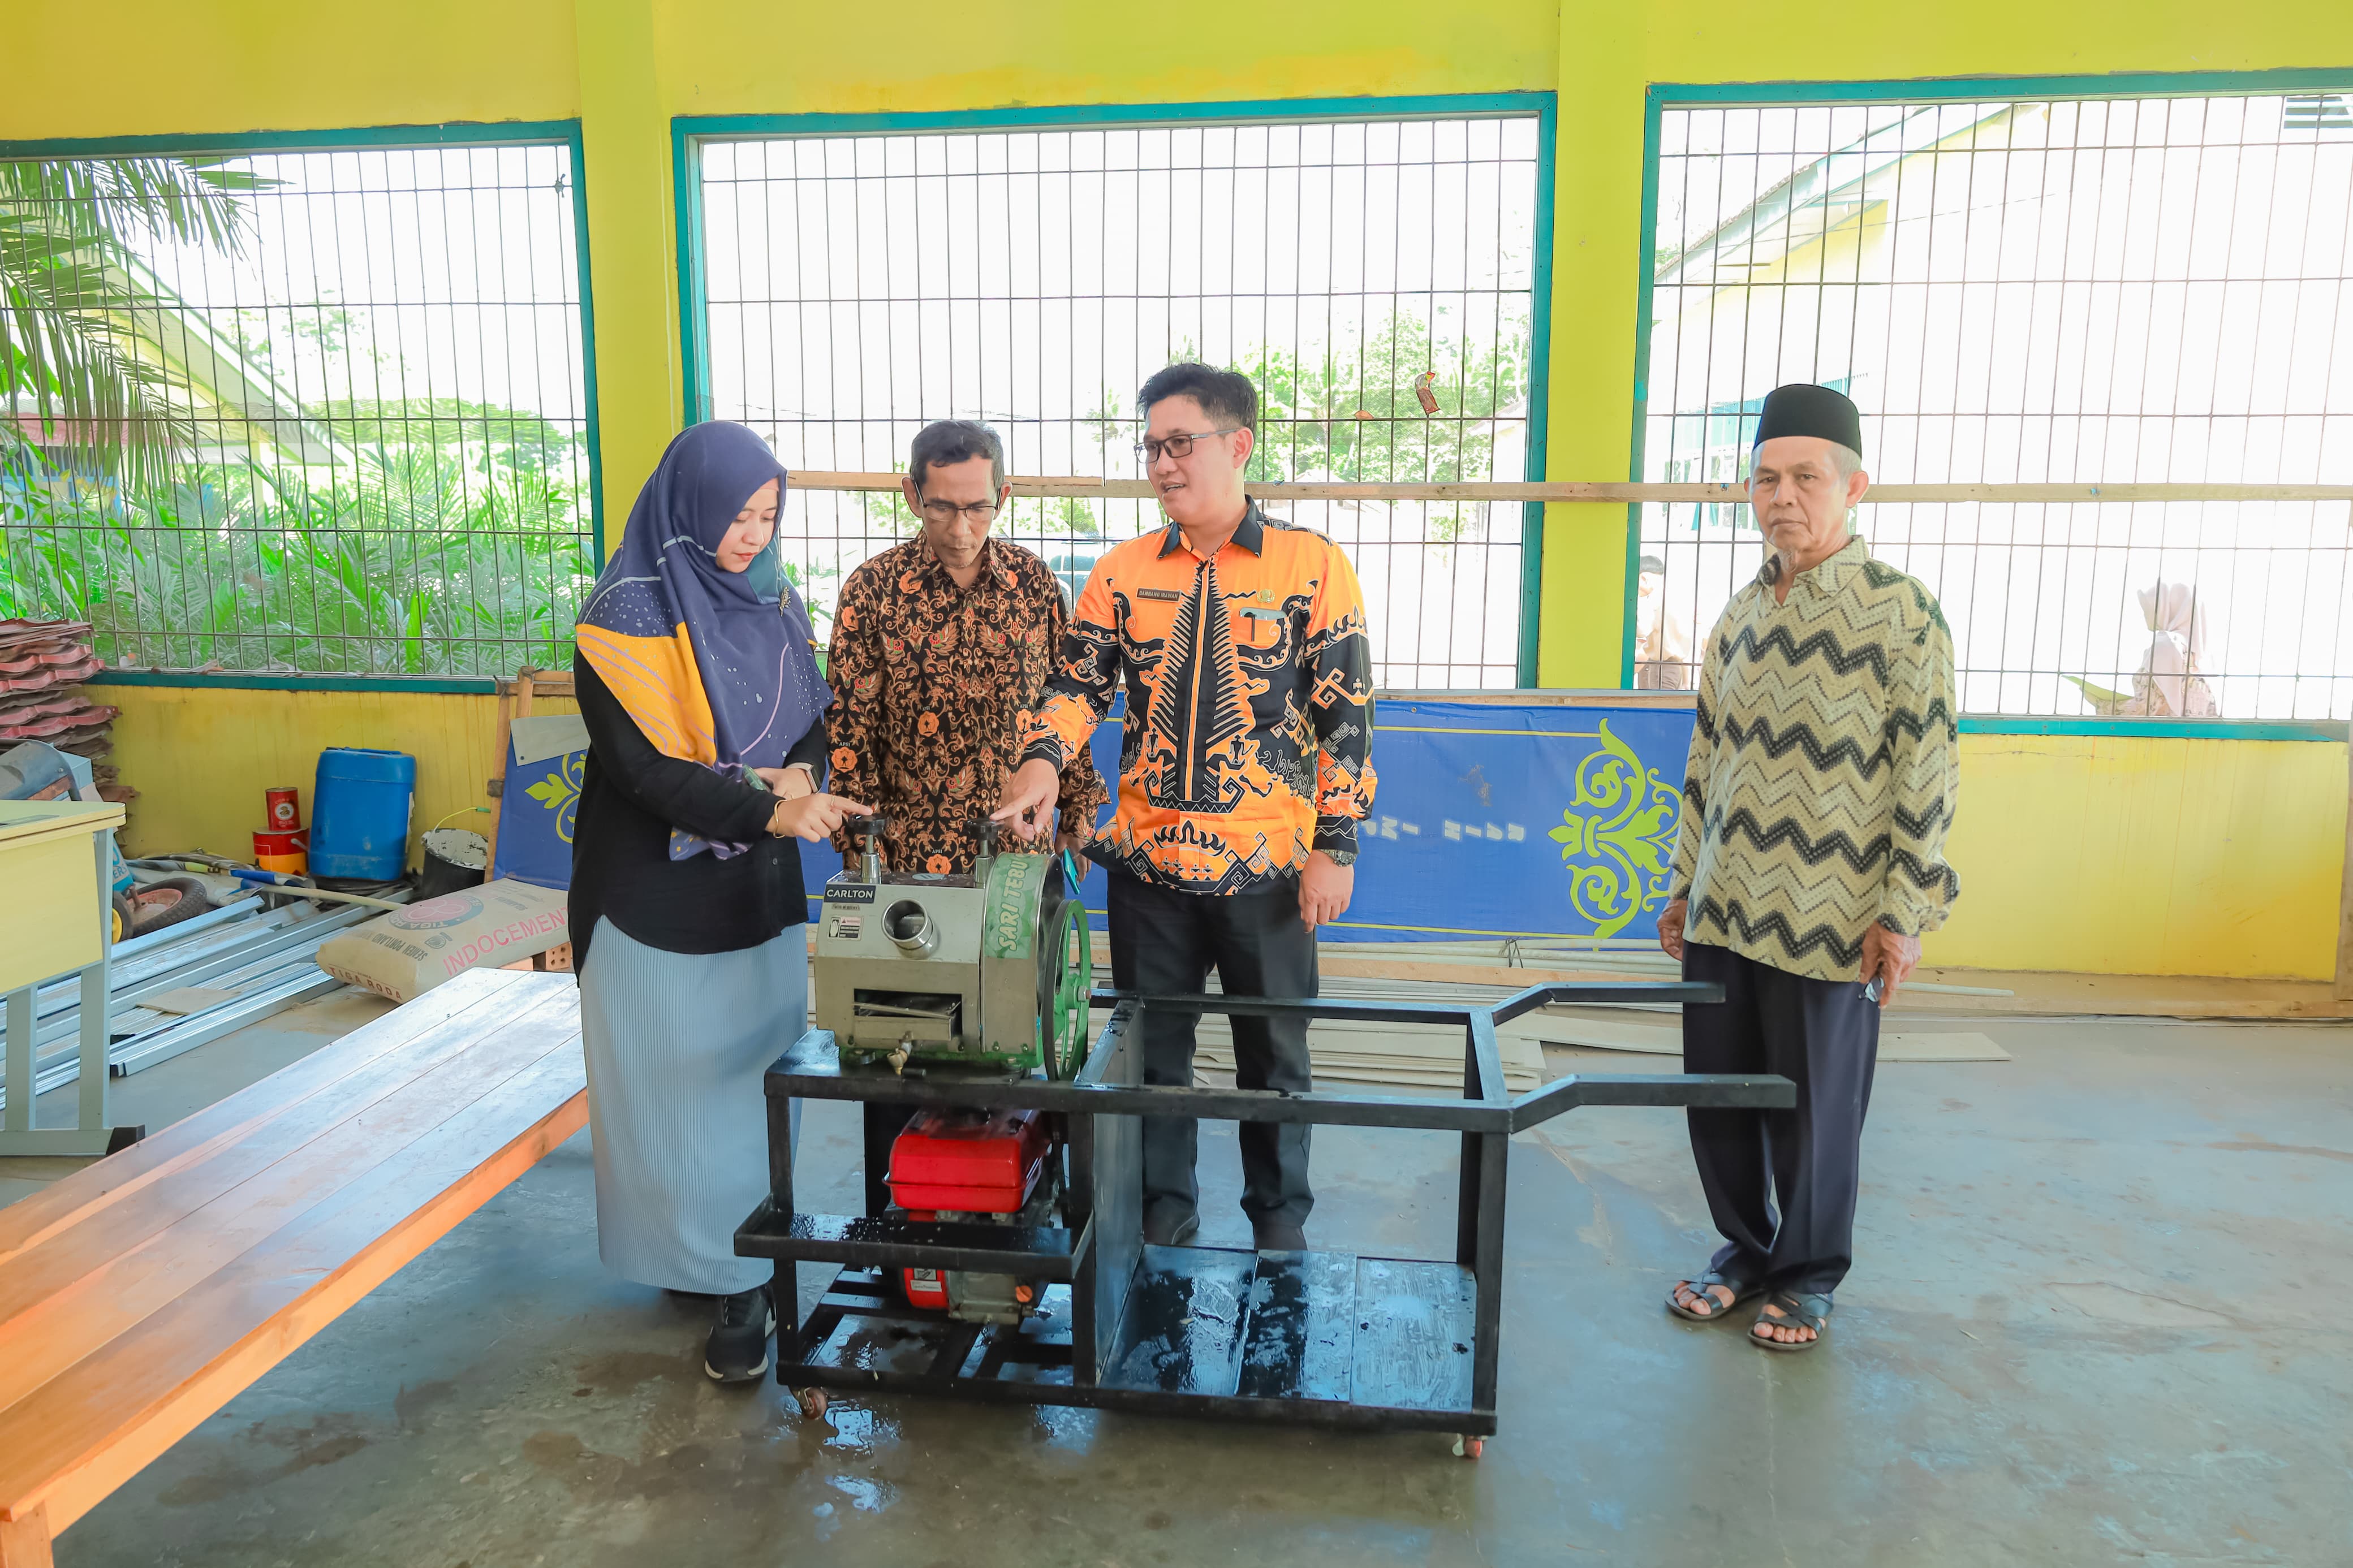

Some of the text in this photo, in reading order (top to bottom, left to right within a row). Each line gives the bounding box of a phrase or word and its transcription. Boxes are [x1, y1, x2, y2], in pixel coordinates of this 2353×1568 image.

[1003, 859, 1029, 898] TEBU
[826, 889, 873, 899] CARLTON
[410, 921, 449, 929] TIGA
[998, 902, 1020, 952] SARI
[371, 932, 407, 952] PORTLAND
[402, 944, 428, 961] SEMEN
[328, 966, 403, 1000] TIGA RODA
